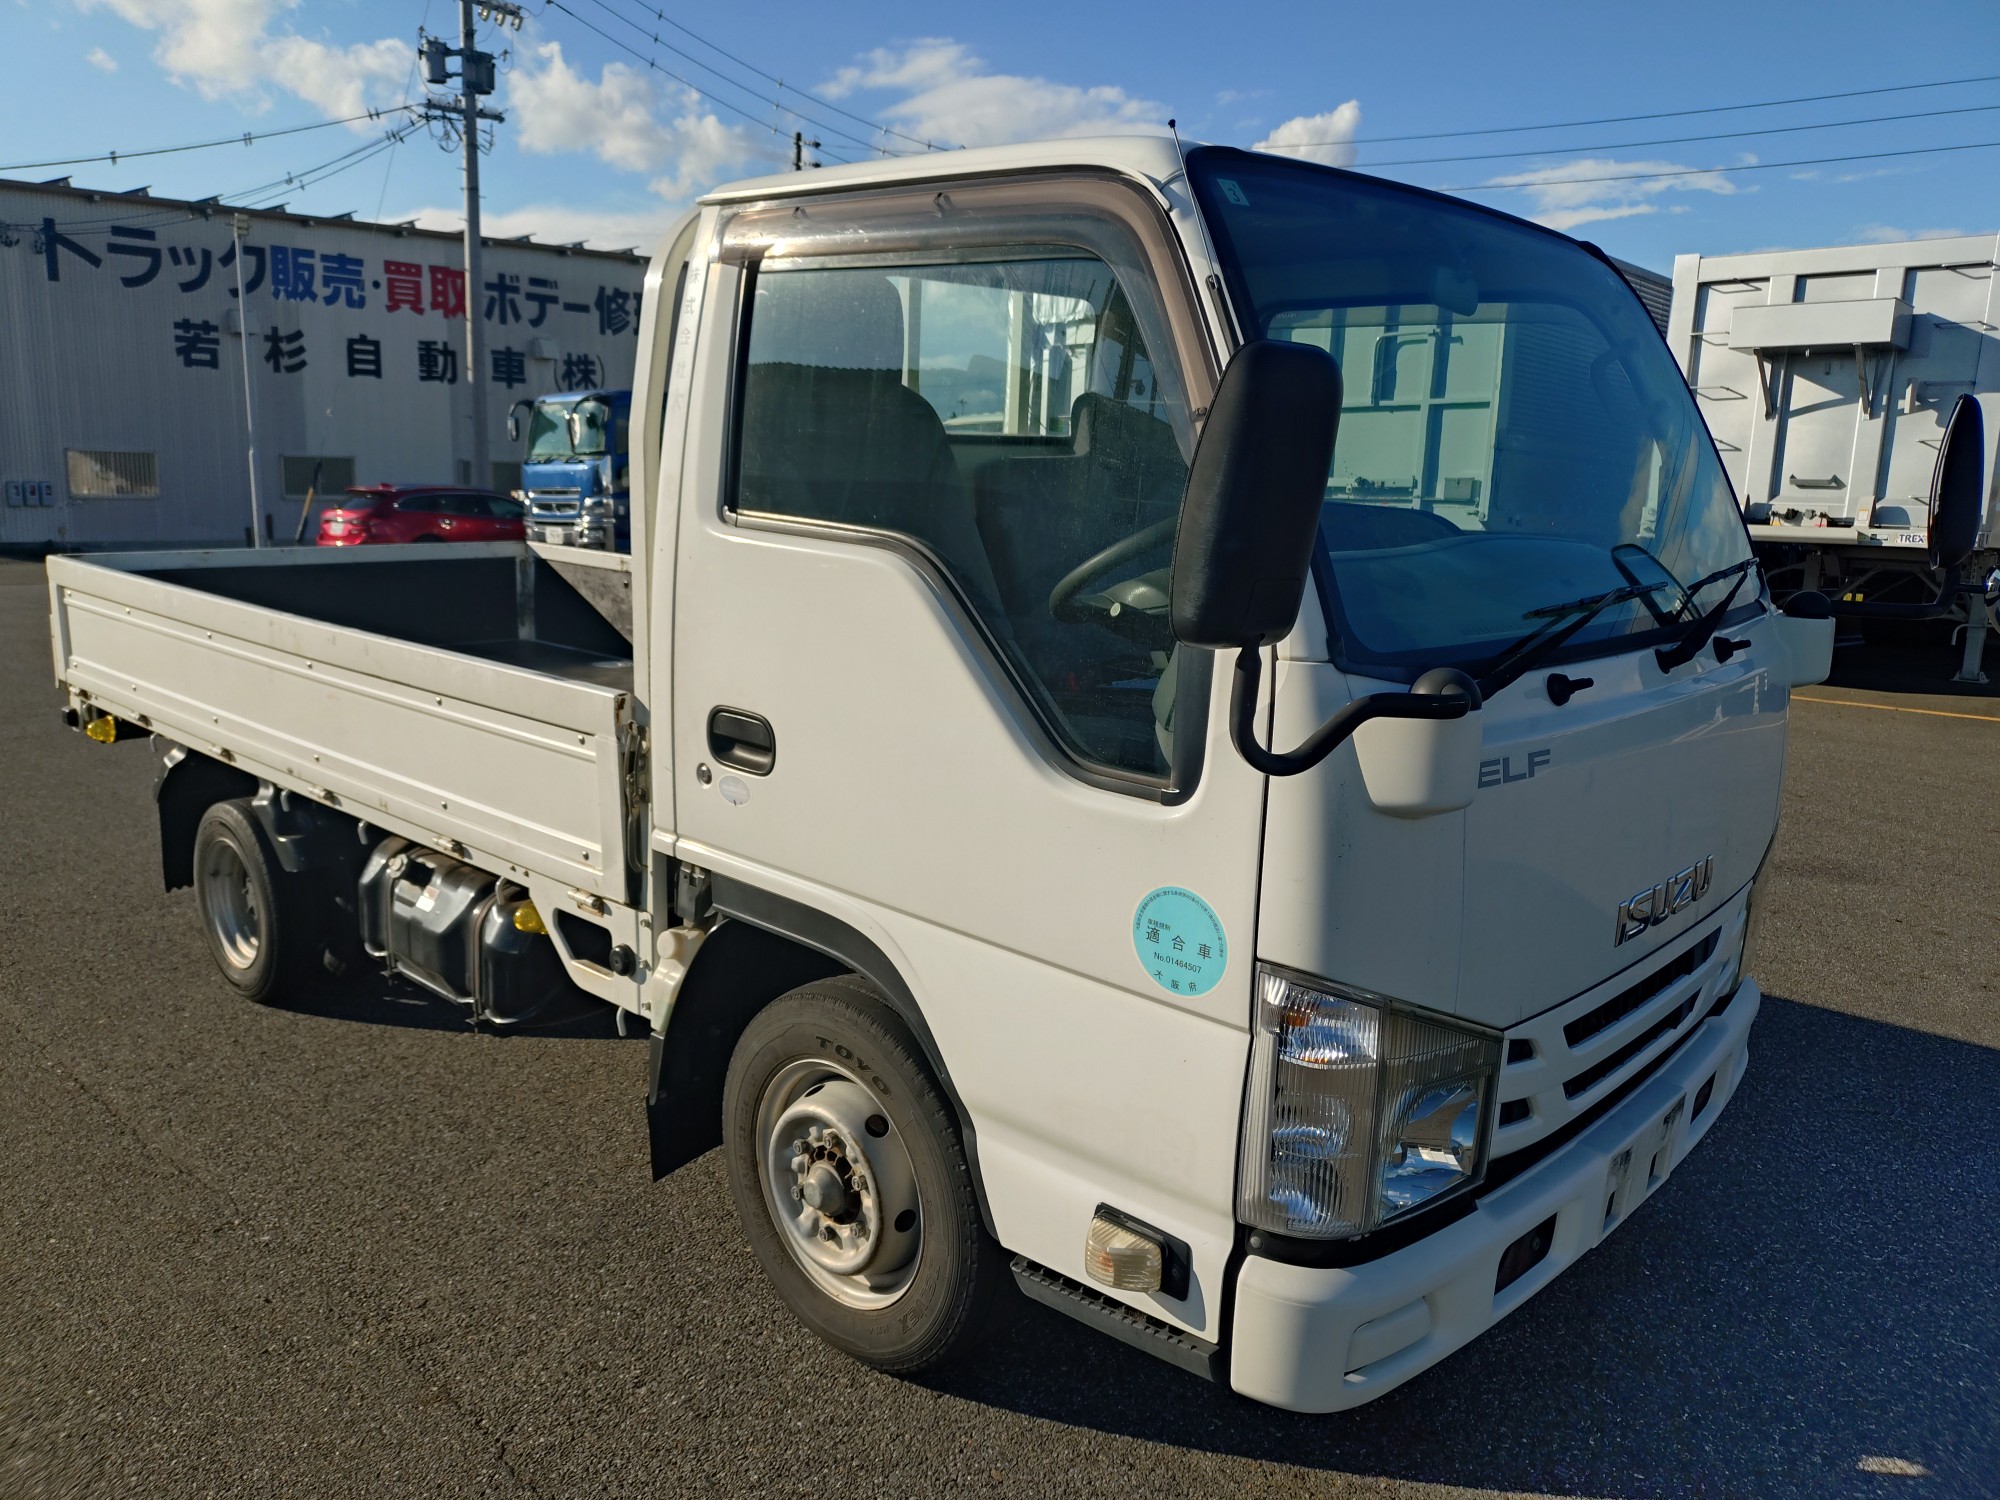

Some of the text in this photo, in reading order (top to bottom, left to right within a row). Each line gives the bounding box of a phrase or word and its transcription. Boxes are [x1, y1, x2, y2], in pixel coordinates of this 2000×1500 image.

[1898, 534, 1925, 544] TREX
[1477, 748, 1551, 788] ELF
[1613, 854, 1714, 948] ISUZU
[1145, 925, 1212, 960] 適合車
[815, 1035, 892, 1098] TOYO
